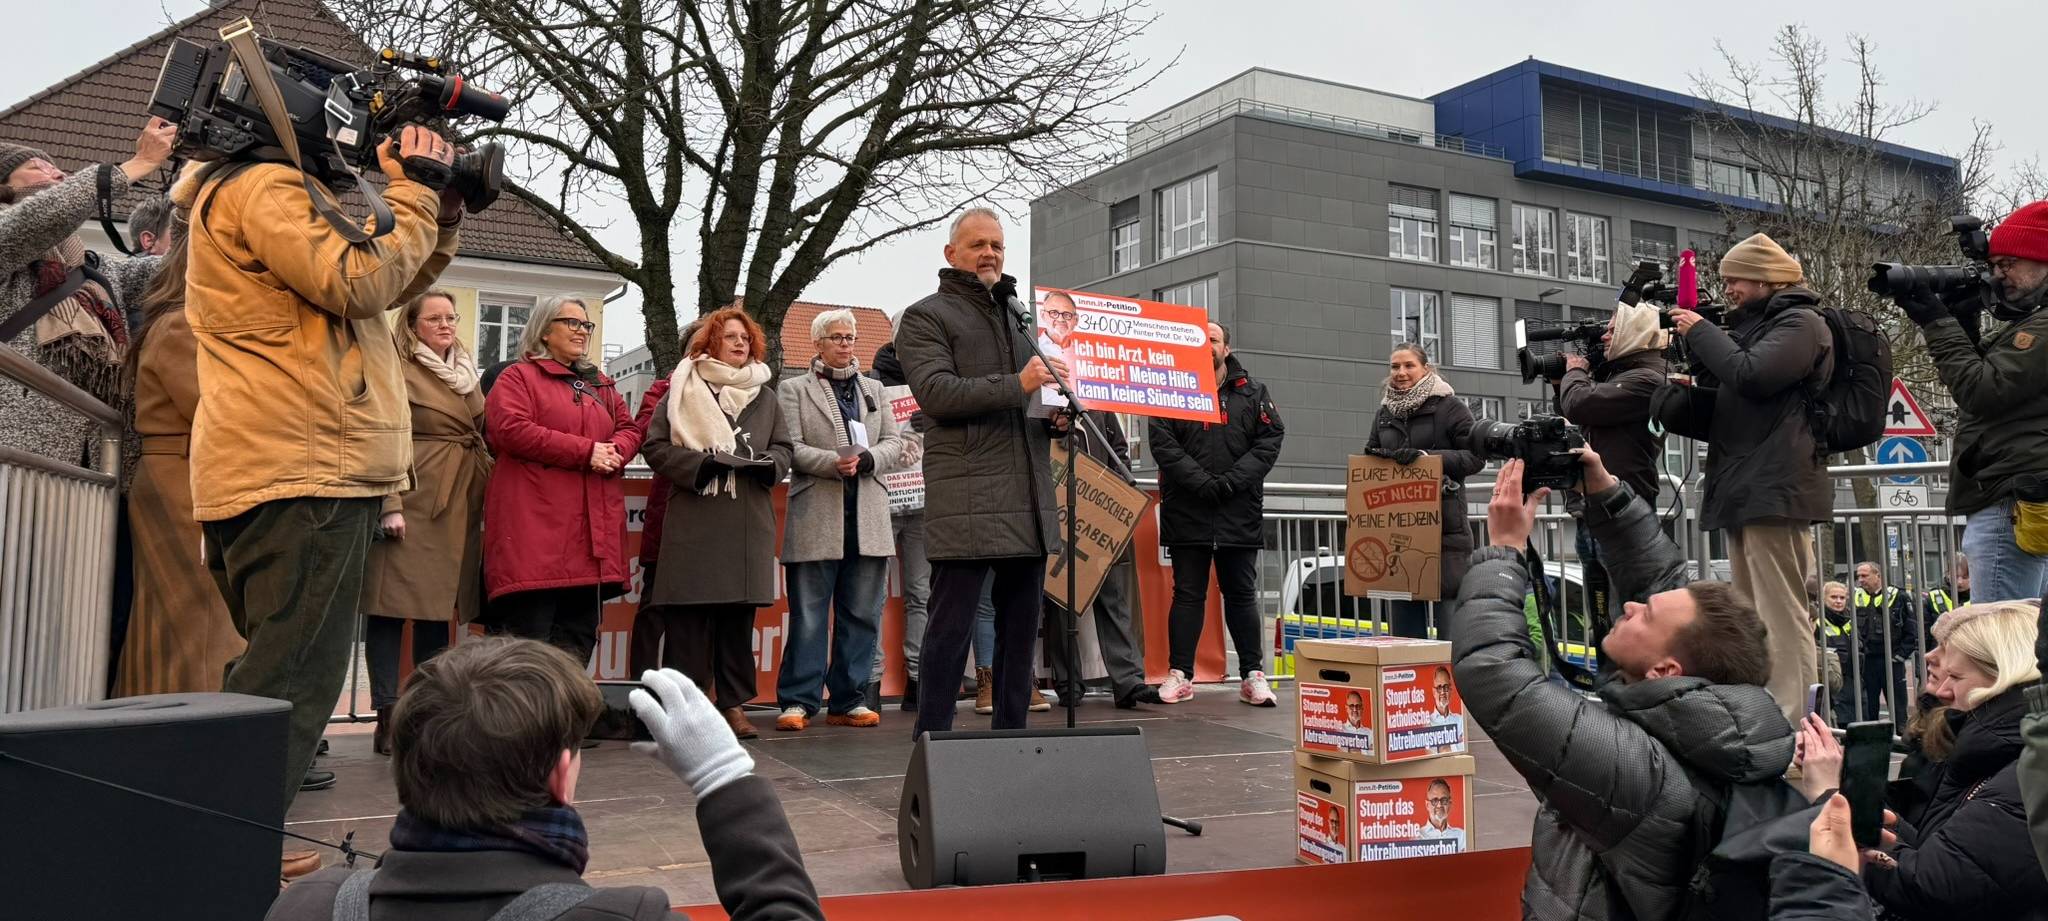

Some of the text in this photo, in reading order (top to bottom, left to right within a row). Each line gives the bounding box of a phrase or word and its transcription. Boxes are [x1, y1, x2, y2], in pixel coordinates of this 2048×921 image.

[1078, 298, 1137, 312] innn.it-Petition
[1133, 320, 1194, 334] Menschen stehen
[1134, 328, 1154, 338] hinter
[1156, 330, 1170, 340] Prof.
[1184, 335, 1200, 343] Volz
[1074, 339, 1174, 367] Ich bin Arzt, kein
[1076, 361, 1197, 389] Mörder! Meine Hilfe
[1077, 381, 1212, 411] kann keine Sünde sein
[1352, 466, 1438, 482] EURE MORAL
[1367, 484, 1434, 505] IST NICHT
[1349, 514, 1385, 528] MEINE
[1303, 698, 1338, 714] Stoppt das
[1386, 686, 1425, 708] Stoppt das
[1304, 714, 1342, 730] katholische
[1387, 707, 1430, 728] katholische
[1304, 729, 1368, 749] Abtreibungsverbot
[1388, 726, 1457, 751] Abtreibungsverbot
[1360, 798, 1414, 819] Stoppt das
[1360, 820, 1420, 840] katholische
